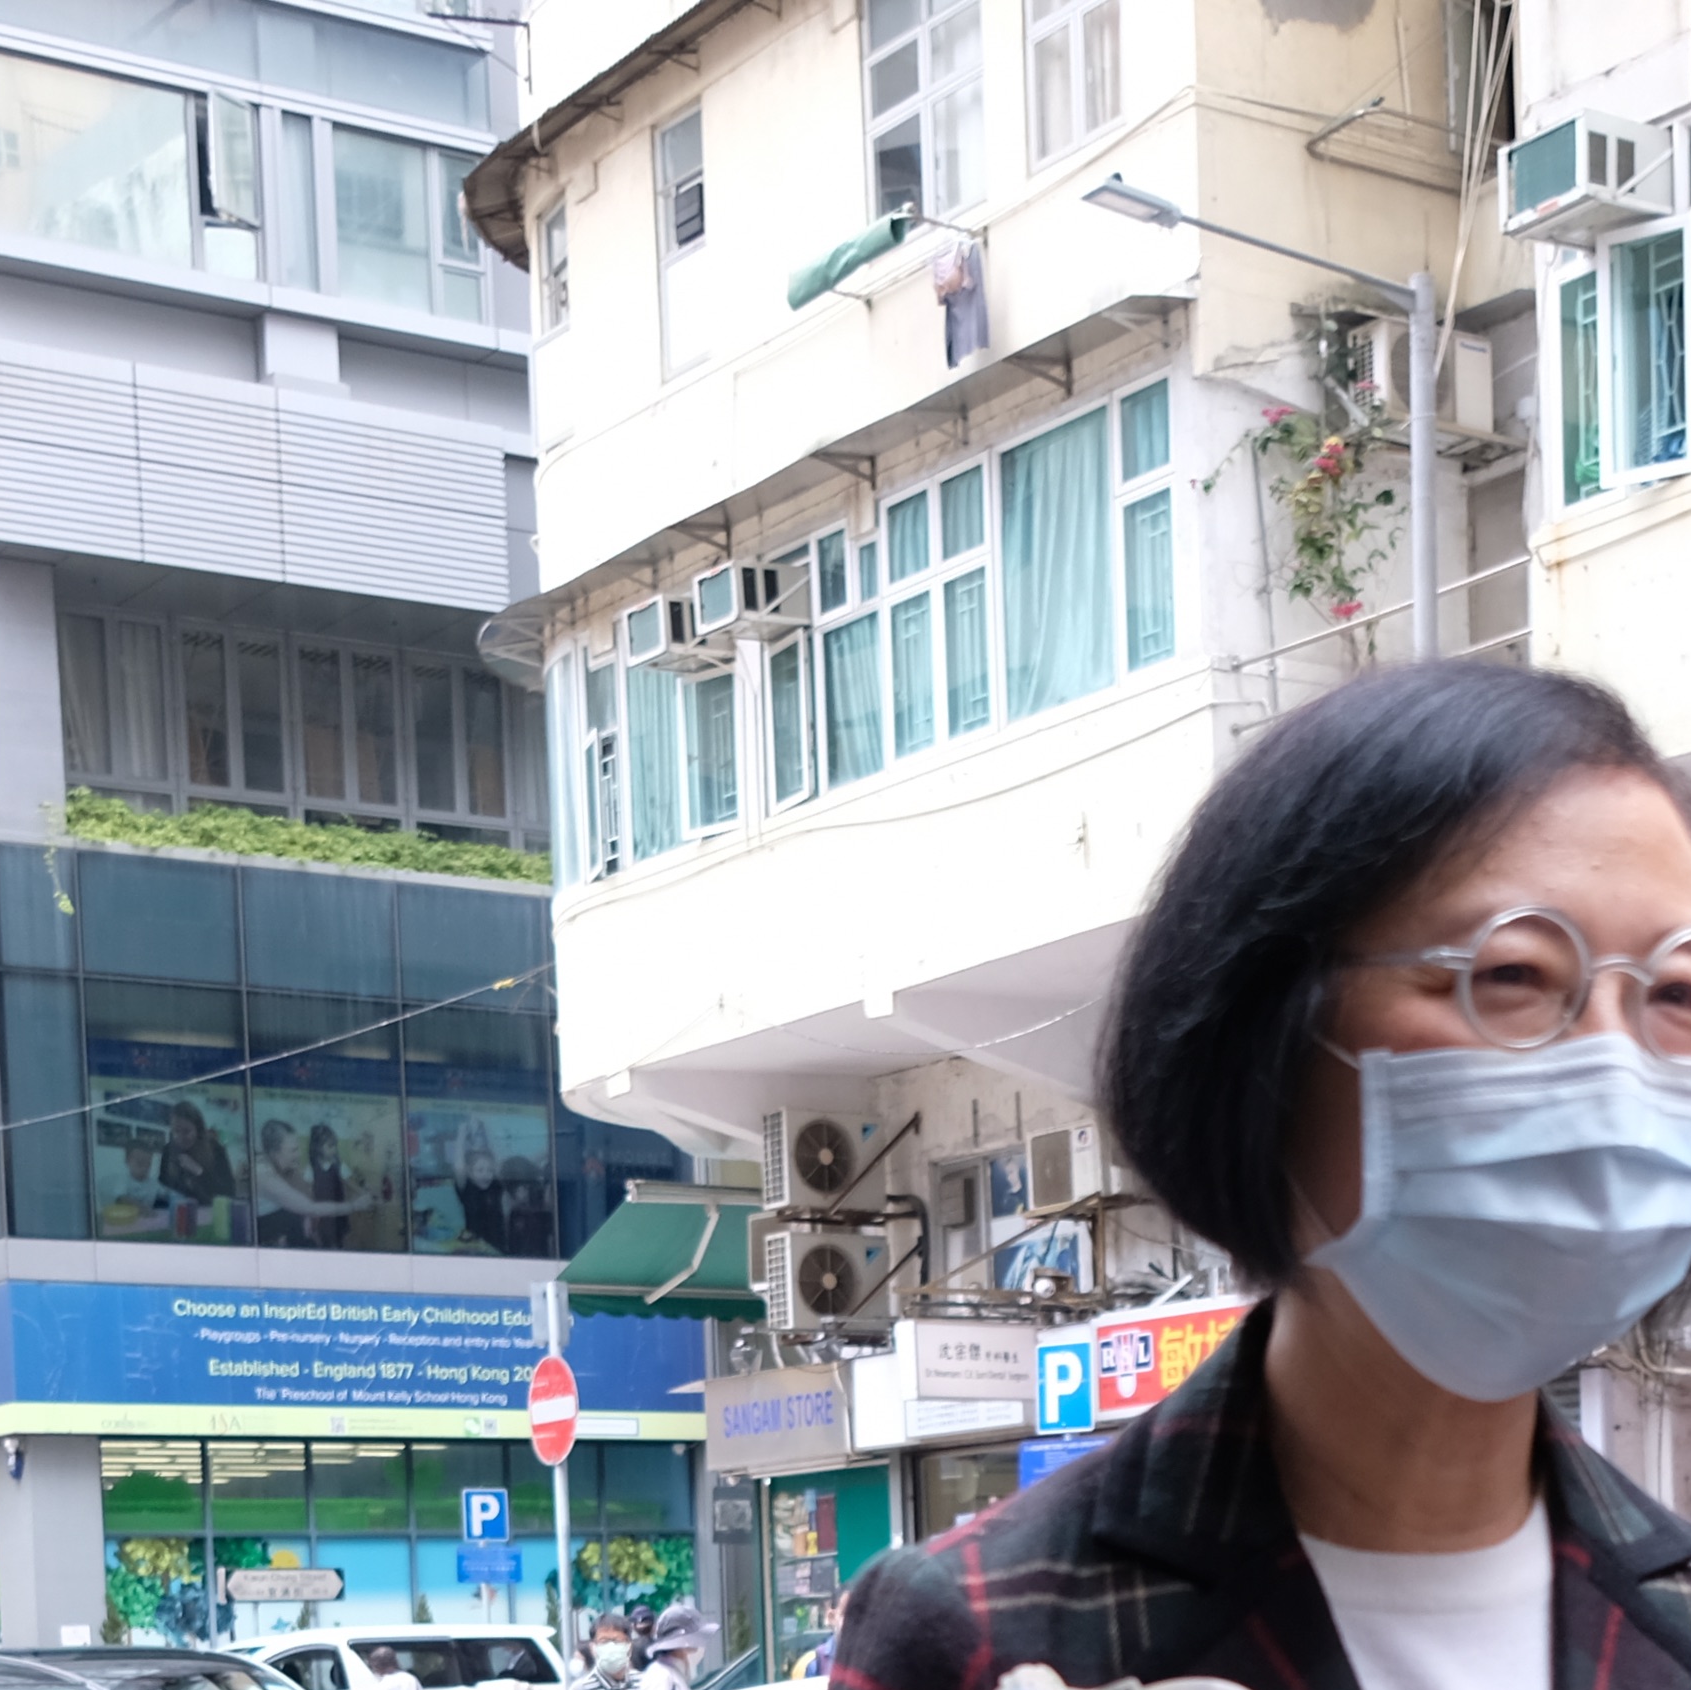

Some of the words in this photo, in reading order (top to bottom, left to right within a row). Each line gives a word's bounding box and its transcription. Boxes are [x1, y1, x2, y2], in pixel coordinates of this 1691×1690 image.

[173, 1298, 236, 1318] Choose
[240, 1303, 260, 1319] an
[264, 1301, 327, 1323] InspirEd
[330, 1303, 378, 1322] British
[382, 1306, 420, 1326] Early
[423, 1306, 500, 1326] Childhood
[208, 1357, 300, 1378] Established
[313, 1361, 376, 1382] England
[380, 1362, 415, 1380] 1877
[426, 1364, 468, 1384] Hong
[471, 1365, 510, 1386] Kong
[1159, 1315, 1239, 1394] 敏
[1044, 1350, 1083, 1424] P
[722, 1398, 782, 1439] SANGAM
[786, 1389, 835, 1430] STORE
[471, 1493, 500, 1537] P
